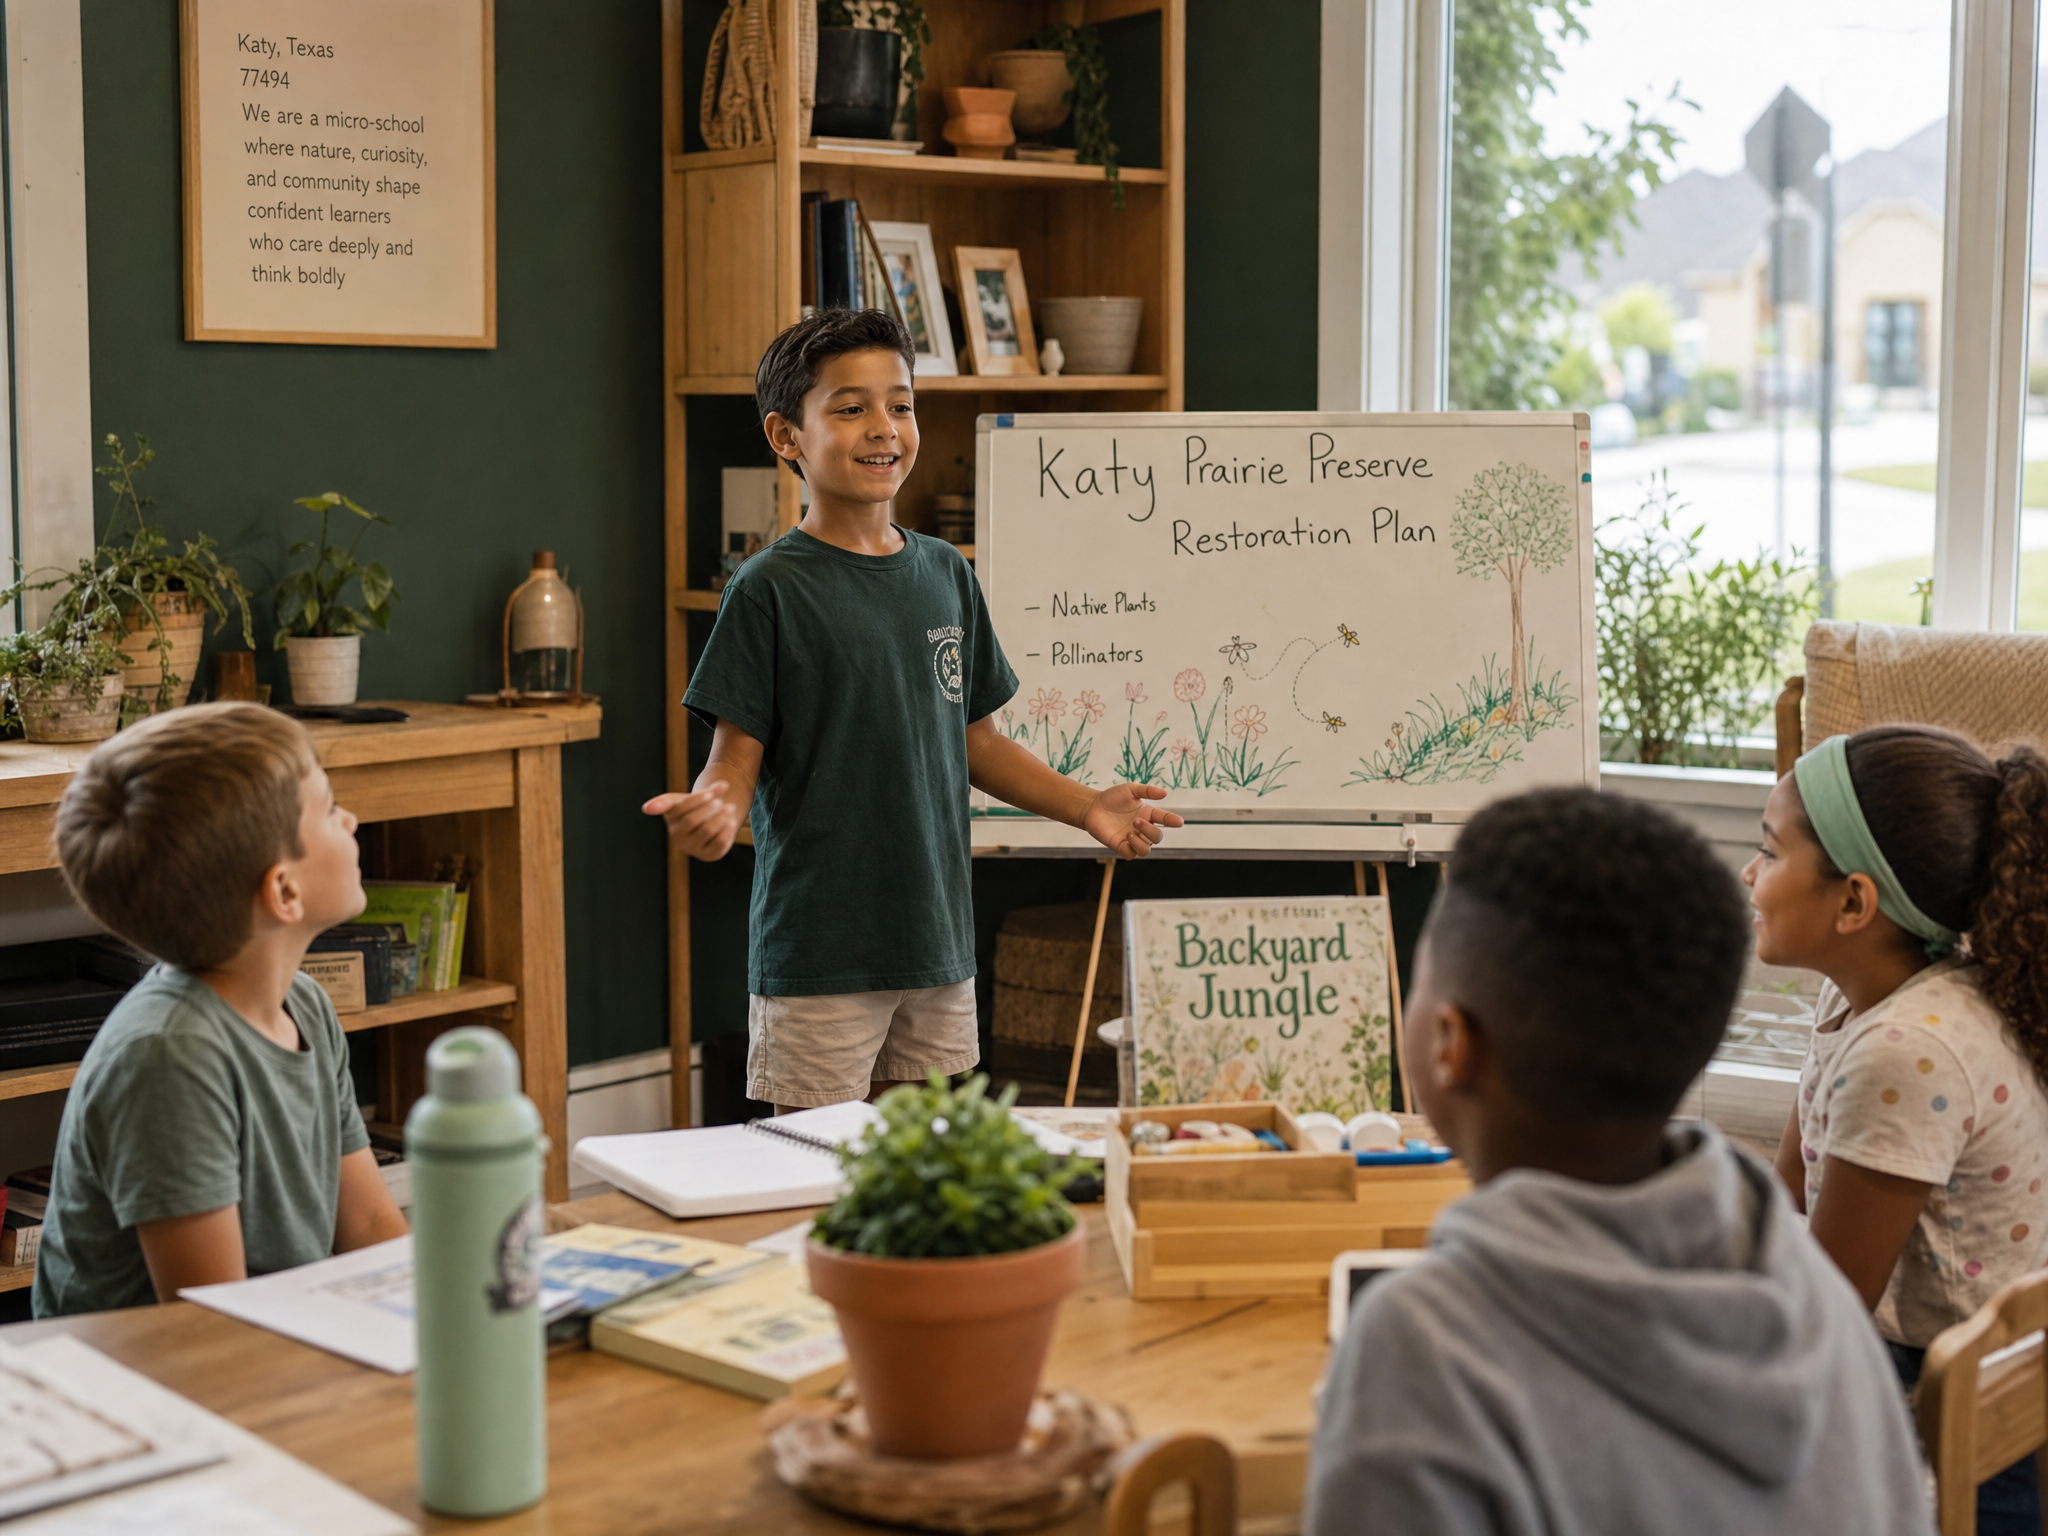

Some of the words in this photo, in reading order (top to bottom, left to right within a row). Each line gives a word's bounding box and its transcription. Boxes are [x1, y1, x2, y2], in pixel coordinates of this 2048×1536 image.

[238, 33, 280, 59] Katy,
[286, 37, 334, 58] Texas
[240, 68, 290, 89] 77494
[242, 103, 270, 123] We
[277, 110, 303, 125] are
[310, 113, 319, 126] a
[326, 111, 424, 133] micro-school
[244, 136, 294, 156] where
[301, 143, 355, 163] nature,
[361, 146, 427, 169] curiosity,
[247, 169, 276, 187] and
[283, 175, 370, 197] community
[376, 176, 420, 199] shape
[248, 201, 323, 221] confident
[330, 204, 391, 224] learners
[249, 232, 283, 251] who
[290, 238, 322, 252] care
[329, 236, 379, 259] deeply
[386, 239, 413, 256] and
[252, 264, 292, 282] think
[298, 266, 345, 290] boldly
[1039, 436, 1156, 522] Katy
[1186, 435, 1288, 485] Prairie
[1310, 432, 1433, 483] Preserve
[1173, 517, 1351, 555] Restoration
[1372, 507, 1435, 544] Plan
[1052, 591, 1108, 618] Native
[1115, 591, 1156, 614] Plants
[1051, 642, 1143, 666] Pollinators
[1175, 922, 1352, 984] Backyard
[1189, 970, 1340, 1039] Jungle
